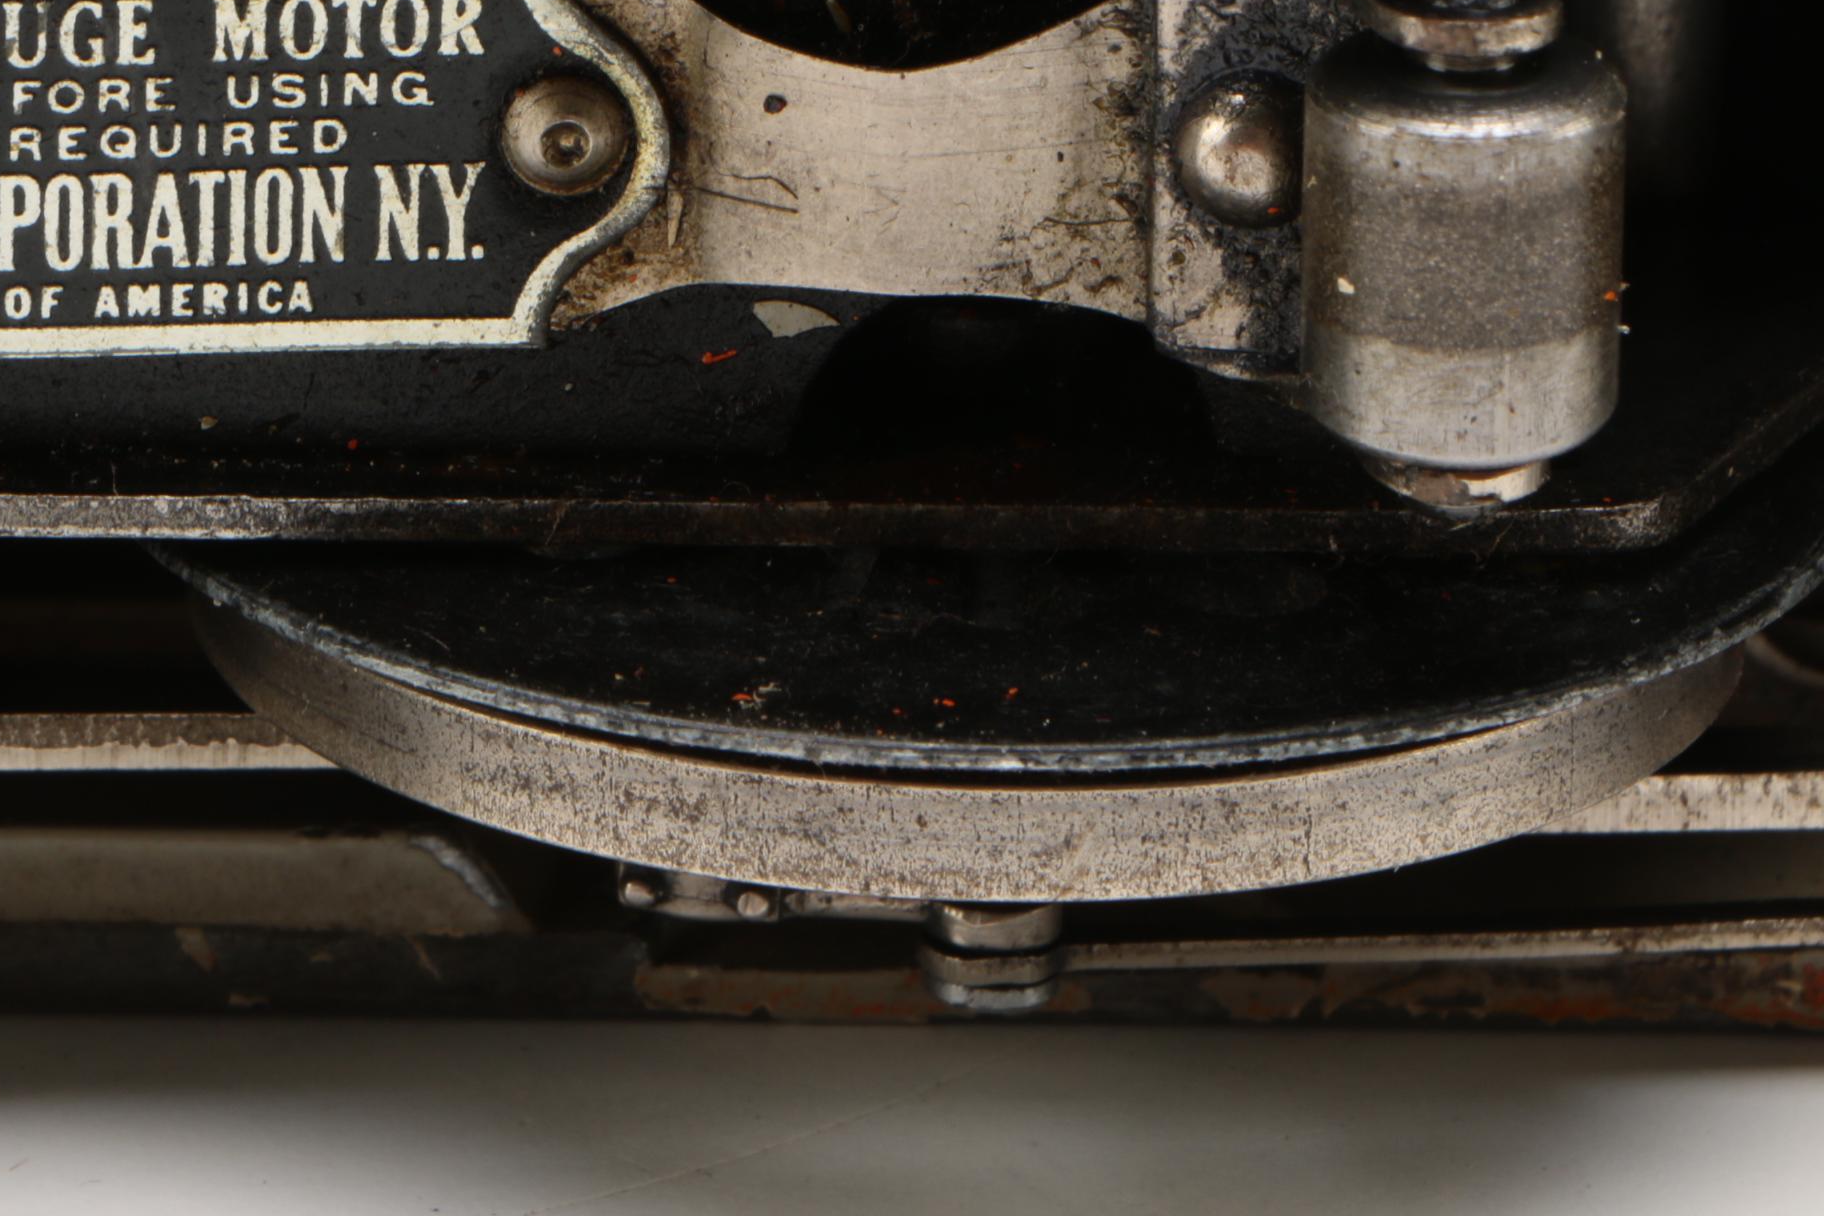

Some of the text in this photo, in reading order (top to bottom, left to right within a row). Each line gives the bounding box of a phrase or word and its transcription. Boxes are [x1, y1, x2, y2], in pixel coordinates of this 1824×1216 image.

[227, 72, 434, 109] USING
[10, 120, 347, 161] REQUIRED
[374, 162, 485, 261] N.Y.
[5, 287, 63, 319] OF
[95, 281, 312, 317] AMERICA
